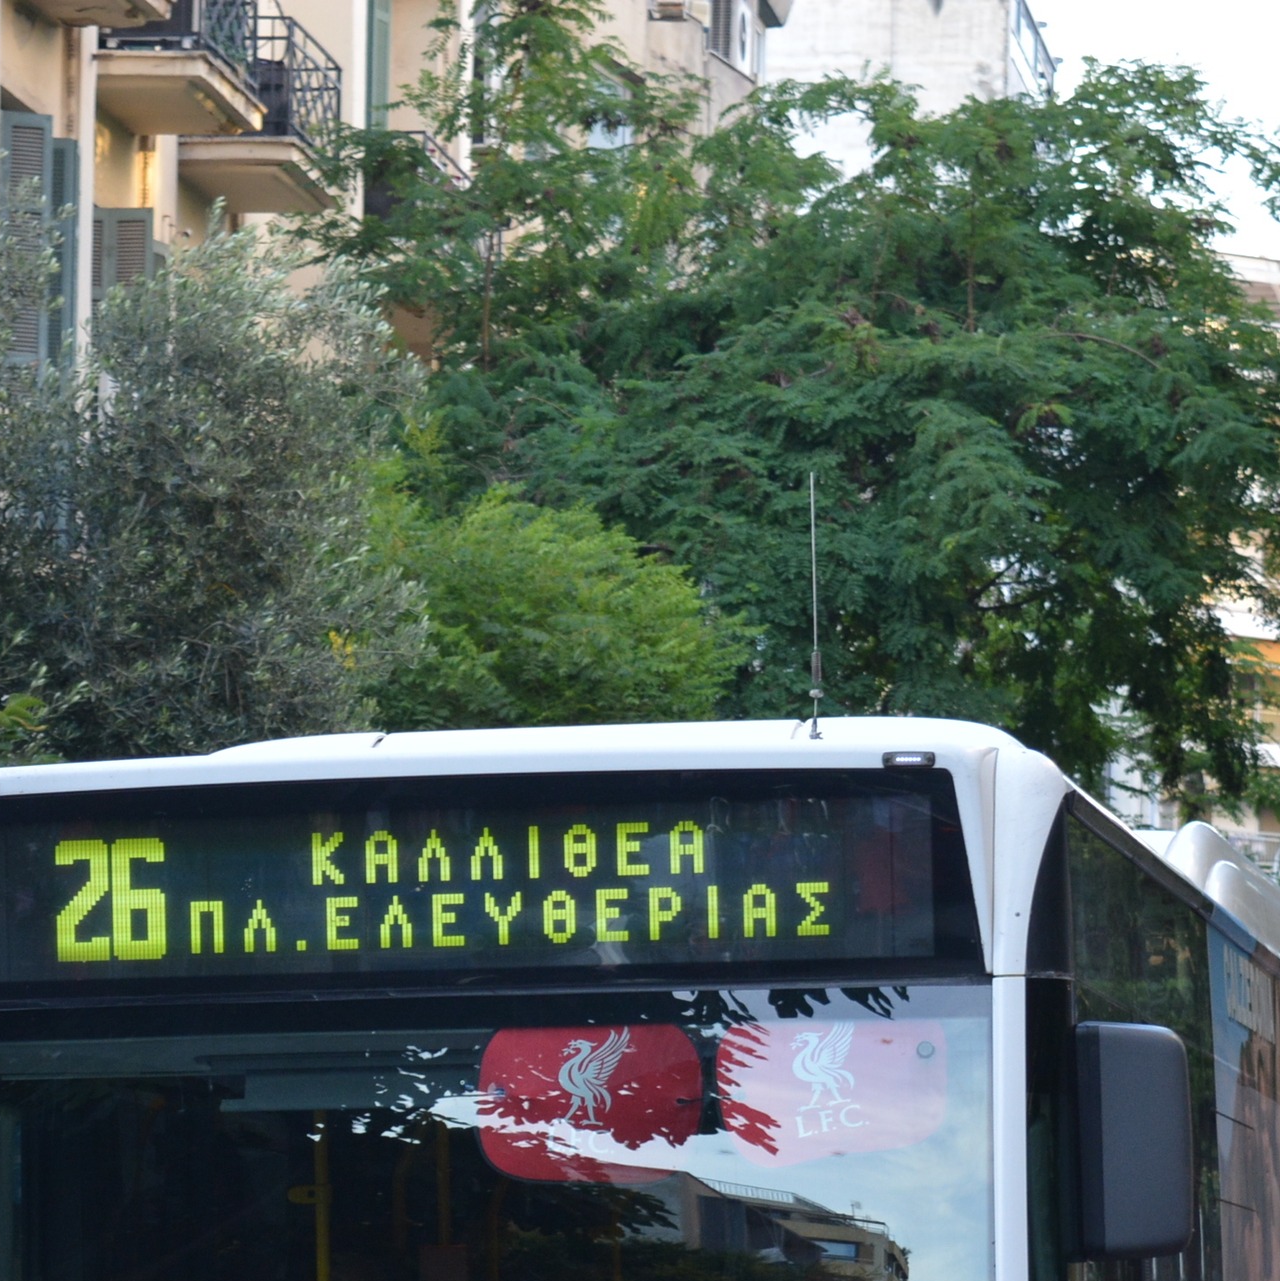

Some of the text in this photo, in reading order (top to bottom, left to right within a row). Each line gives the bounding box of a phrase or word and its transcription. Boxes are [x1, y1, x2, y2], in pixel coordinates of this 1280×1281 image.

[311, 820, 705, 886] ΚΑΛΛΙΘΕΑ
[55, 838, 167, 962] 26
[795, 1104, 871, 1138] L.F.C.
